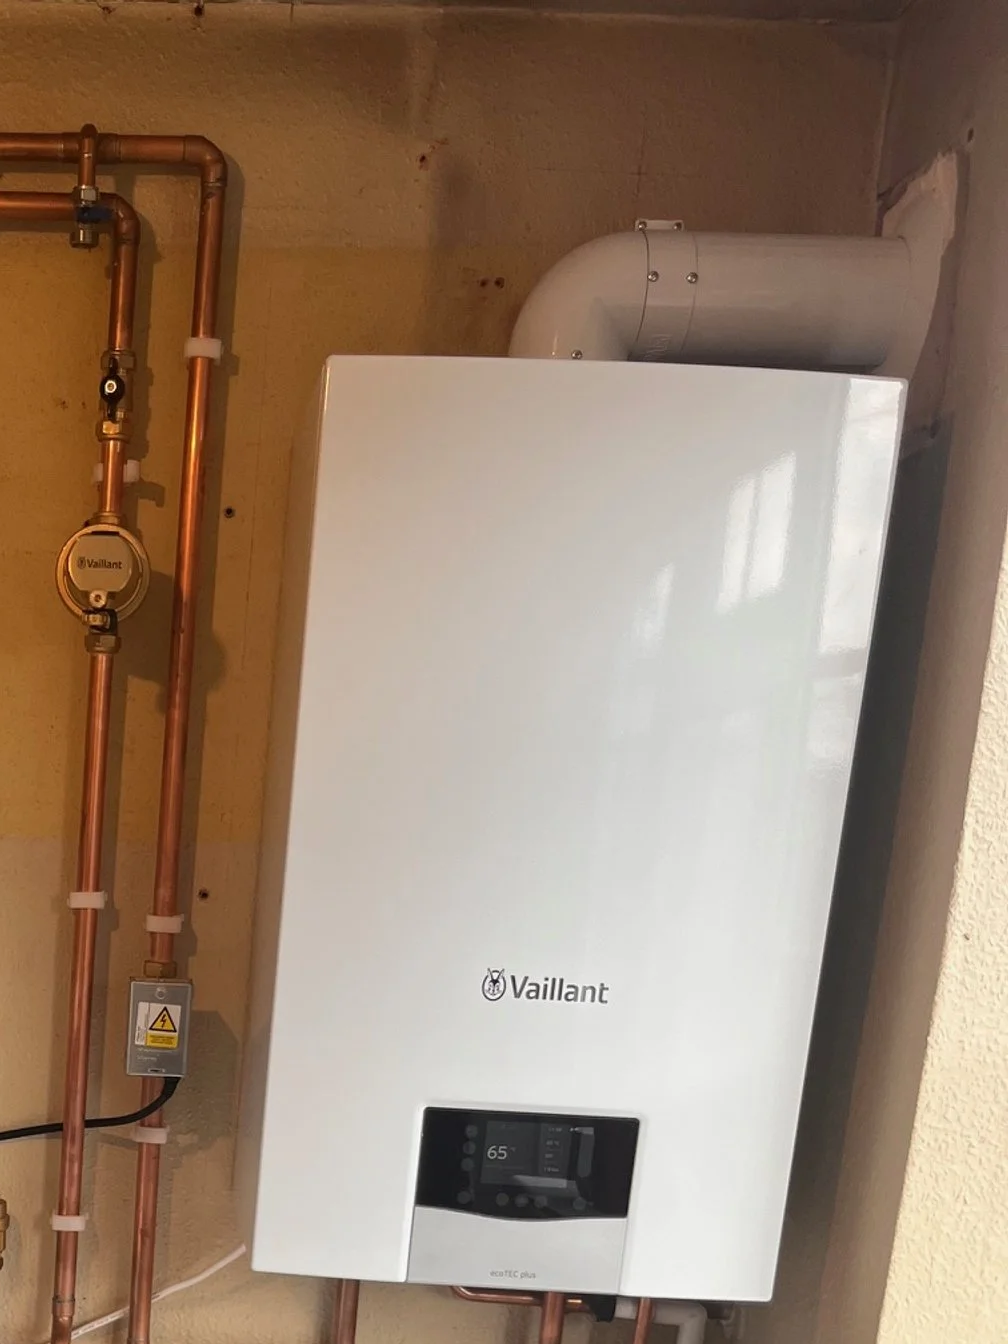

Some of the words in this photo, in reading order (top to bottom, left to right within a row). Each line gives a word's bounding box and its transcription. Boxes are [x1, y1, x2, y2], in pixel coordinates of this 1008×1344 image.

[86, 558, 123, 570] Vaillant
[510, 974, 610, 1004] Vaillant
[487, 1145, 508, 1160] 65
[489, 1269, 519, 1279] ecoTEC
[520, 1270, 537, 1280] plus
